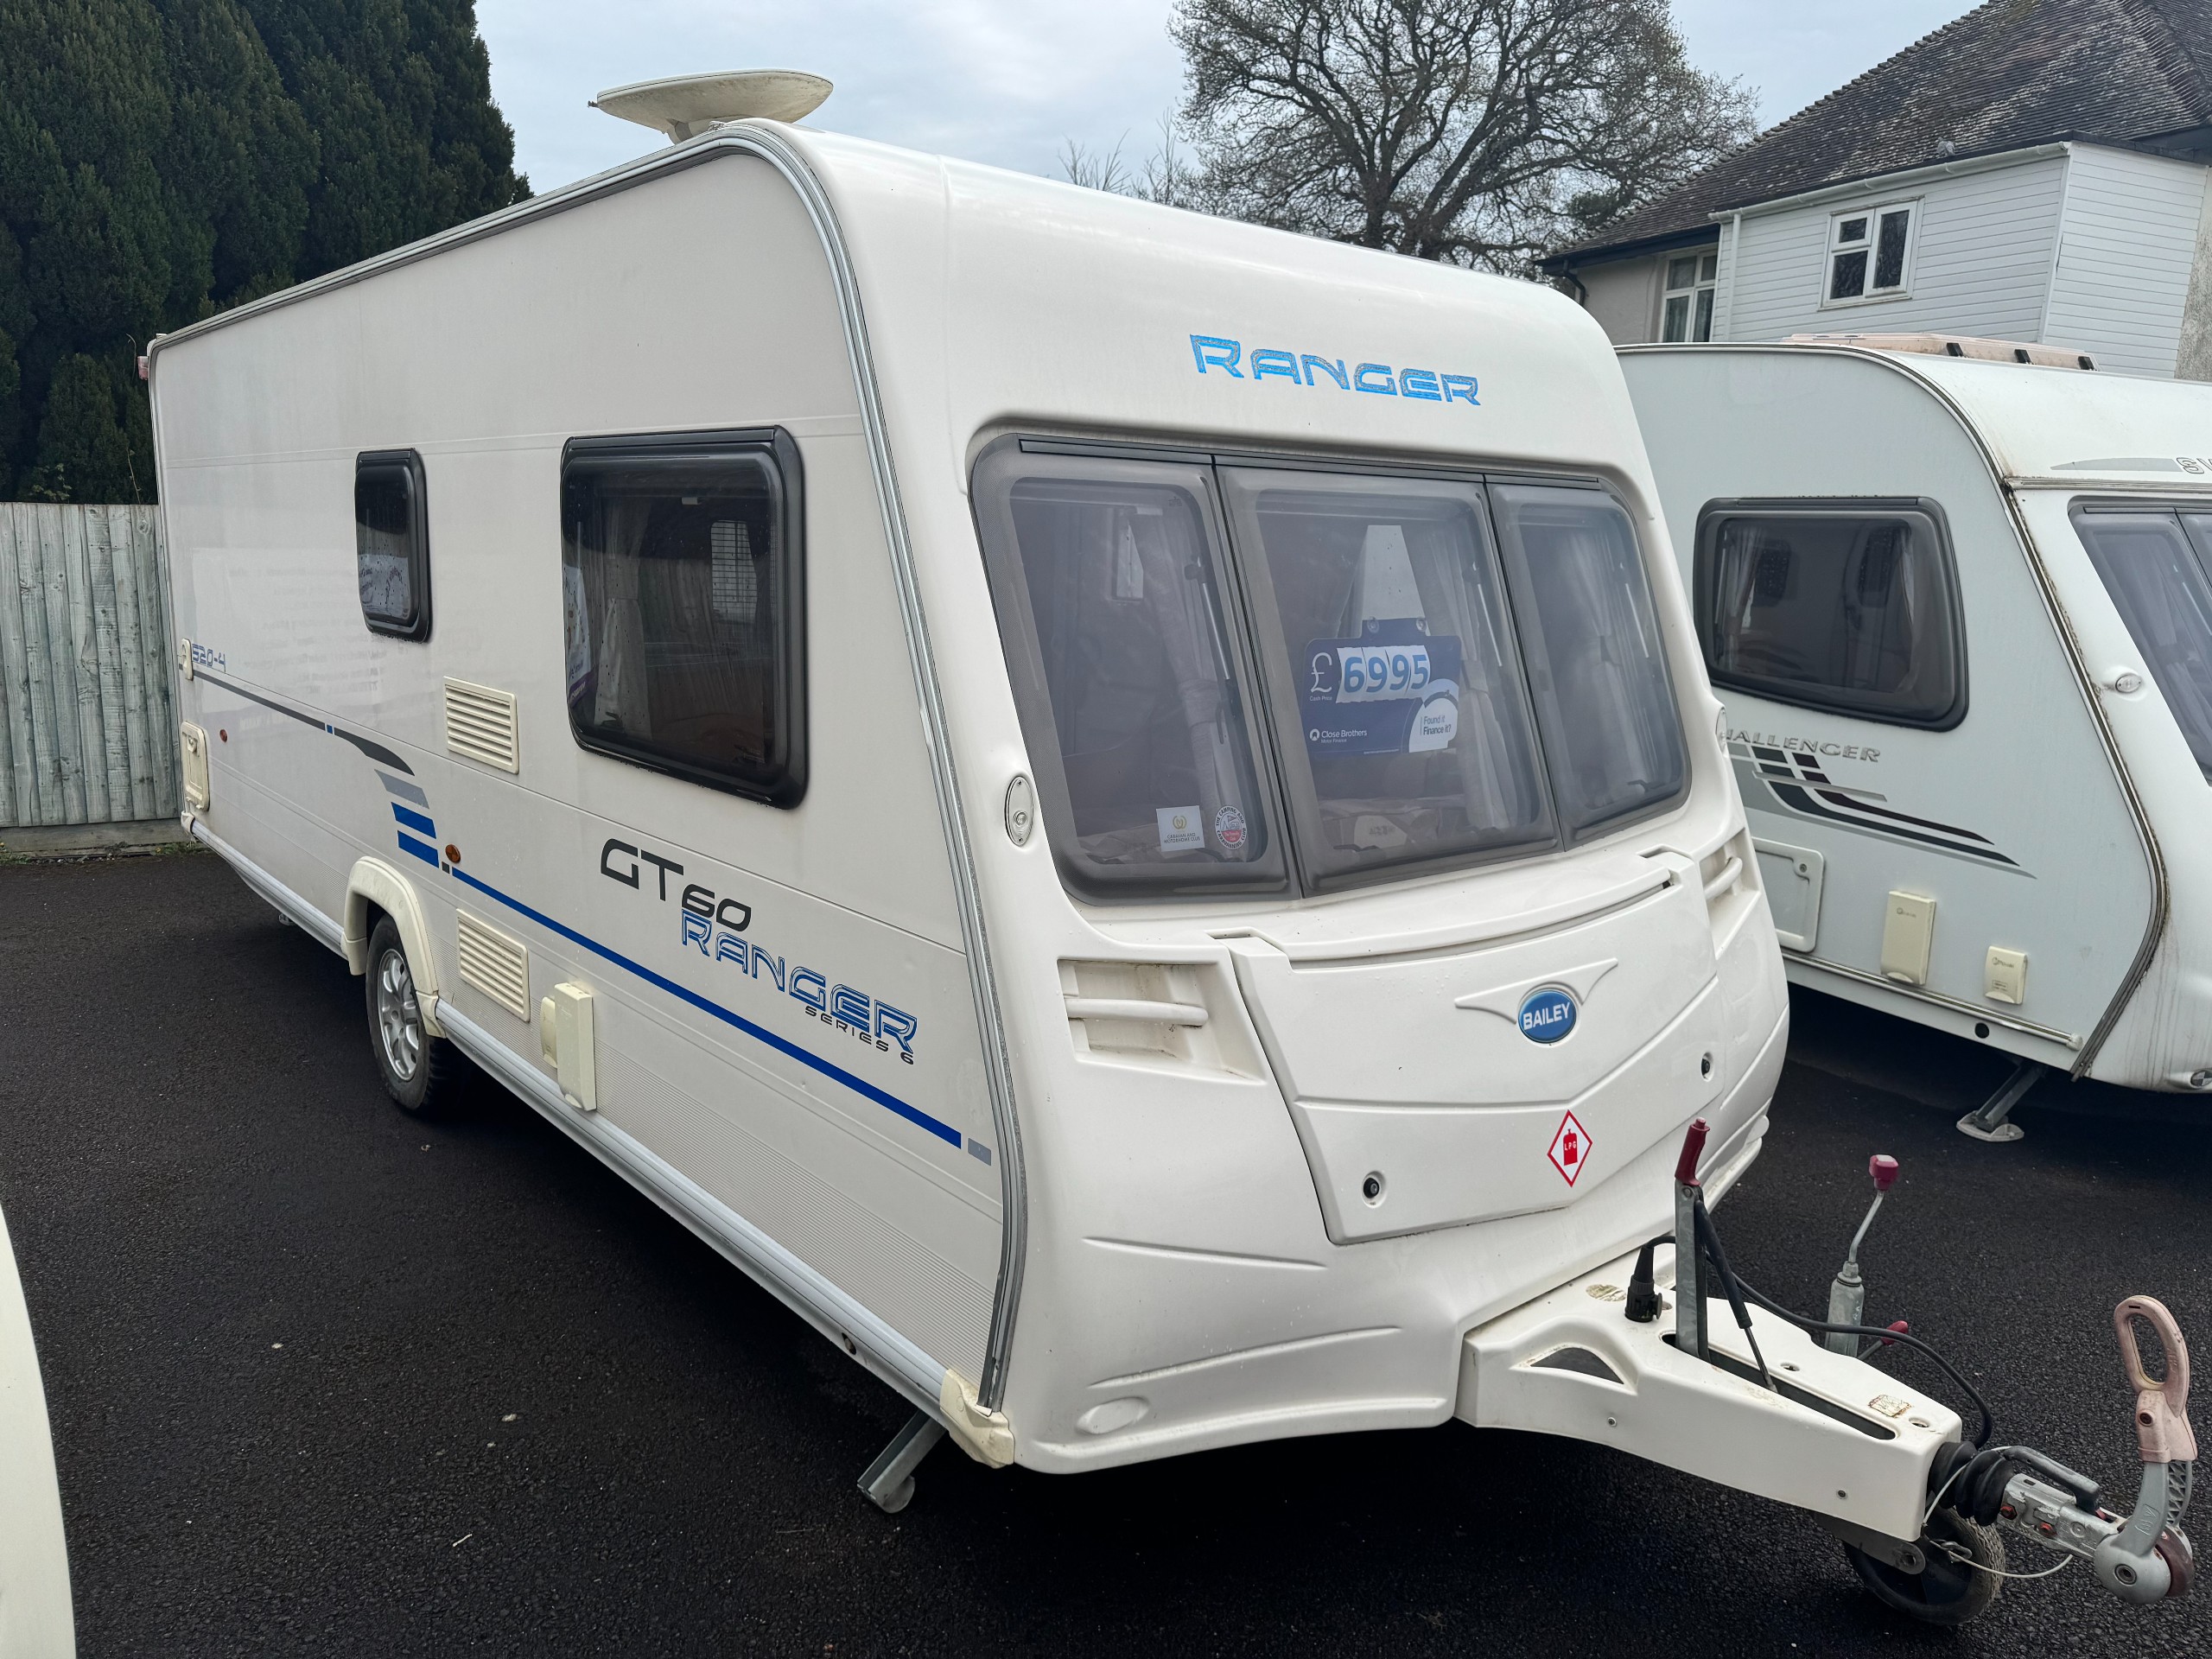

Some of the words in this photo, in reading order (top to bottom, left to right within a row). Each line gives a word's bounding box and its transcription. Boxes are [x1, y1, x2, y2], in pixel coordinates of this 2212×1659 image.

[1189, 334, 1481, 406] RANGER
[1341, 729, 1368, 738] Brothers
[1423, 715, 1440, 725] Found
[1423, 726, 1444, 735] Finance
[1726, 728, 1881, 763] ALLENGER
[681, 908, 918, 1054] RANGER
[1522, 1001, 1571, 1031] BAILEY
[804, 1005, 889, 1052] SERIES
[900, 1052, 914, 1065] 6
[1564, 1141, 1577, 1151] LPG
